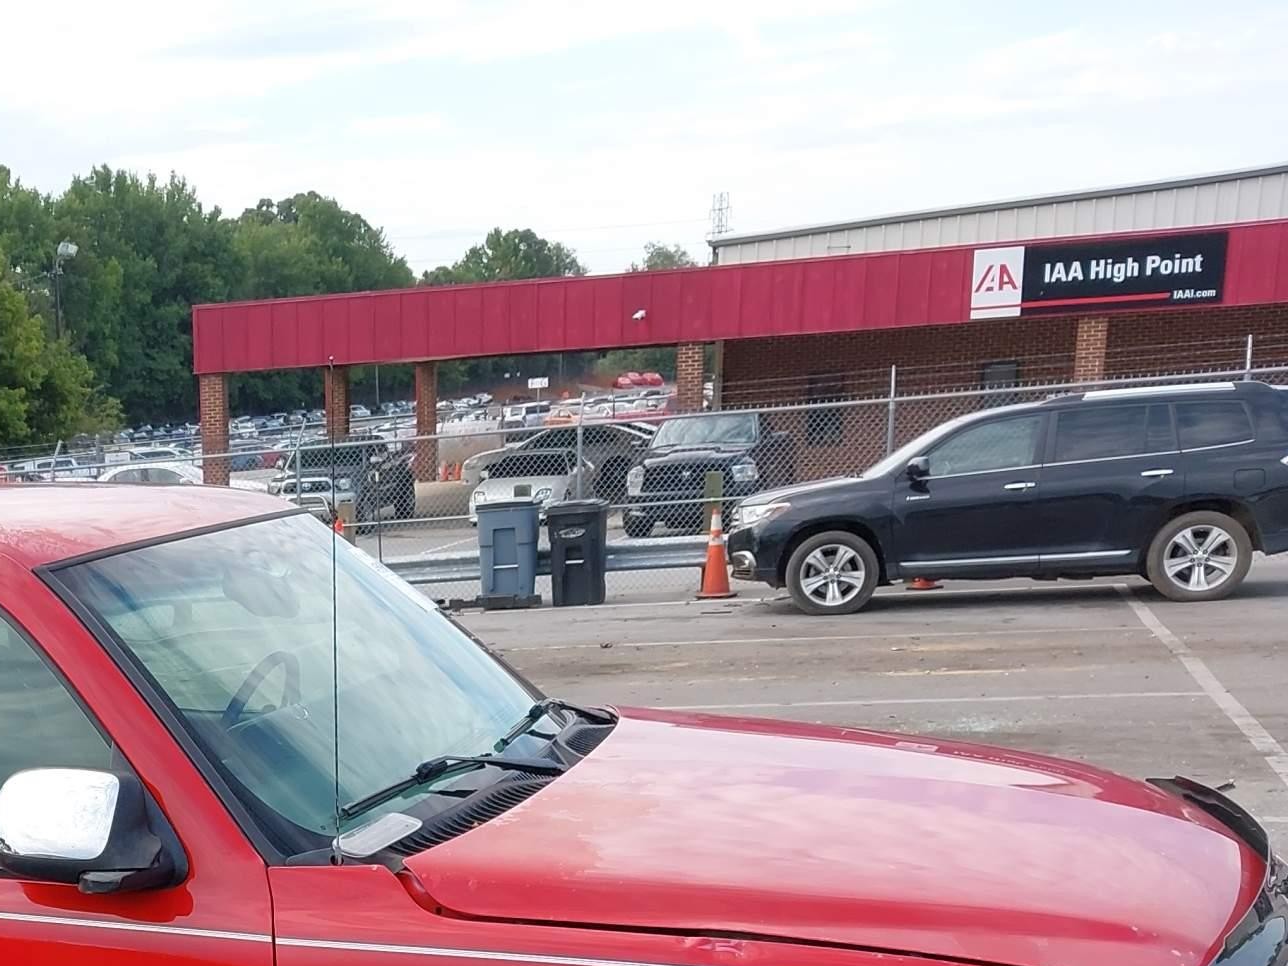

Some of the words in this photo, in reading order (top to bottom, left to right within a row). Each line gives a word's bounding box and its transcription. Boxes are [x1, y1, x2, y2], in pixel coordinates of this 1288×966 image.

[1044, 261, 1084, 283] IAA
[1090, 256, 1139, 283] High
[1145, 253, 1204, 276] Point
